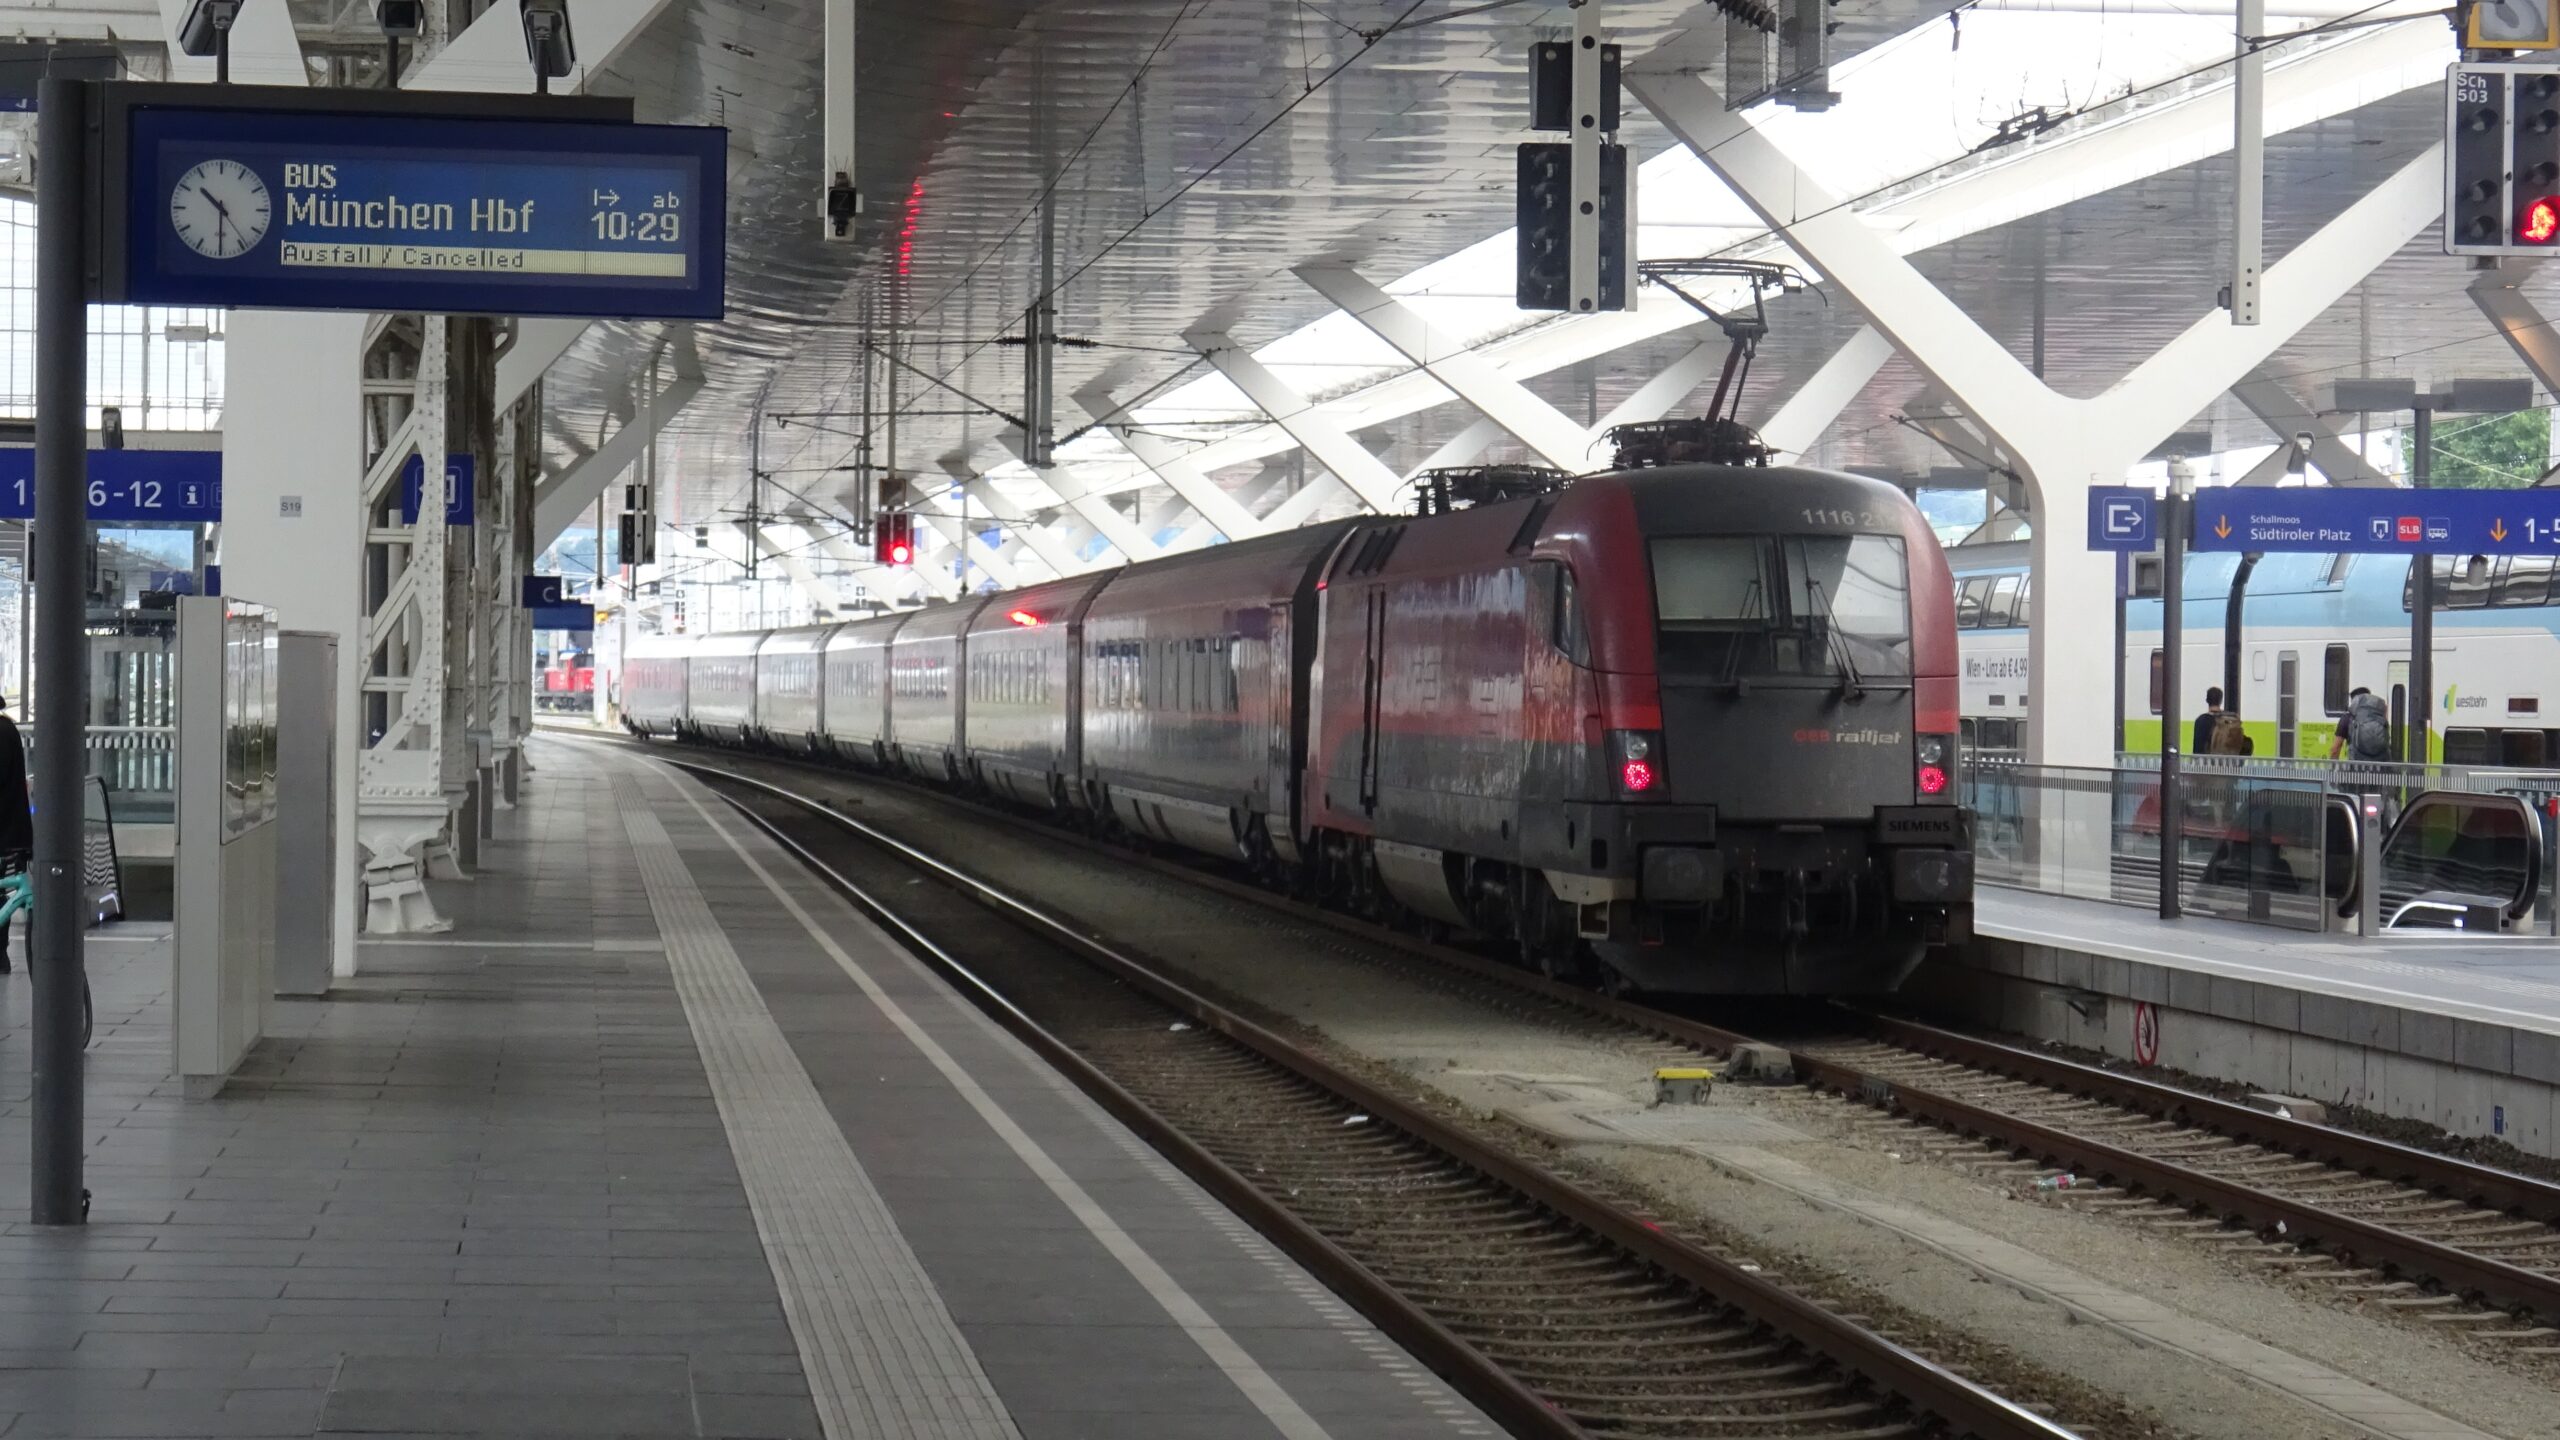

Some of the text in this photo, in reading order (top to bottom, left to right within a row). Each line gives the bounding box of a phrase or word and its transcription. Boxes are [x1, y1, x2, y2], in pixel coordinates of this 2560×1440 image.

[2458, 89, 2488, 103] 503
[284, 163, 337, 189] BUS
[653, 192, 680, 208] ab
[286, 193, 534, 233] München Hbf
[591, 211, 679, 242] 10:29
[284, 245, 371, 264] Ausfall
[403, 248, 523, 268] Cancelled
[281, 502, 302, 511] S19
[1802, 509, 1855, 526] 1116
[2250, 515, 2301, 524] Schallmoos
[2250, 527, 2352, 541] Südtiroler Platz
[2400, 526, 2420, 534] SLB
[542, 586, 555, 603] C
[1966, 658, 1981, 678] Wien
[1986, 657, 1998, 678] Linz
[1999, 658, 2007, 678] ab
[2008, 657, 2013, 678] €
[2456, 696, 2487, 708] westbahn
[1836, 729, 1902, 745] railjet
[1889, 821, 1951, 832] SIEMENS
